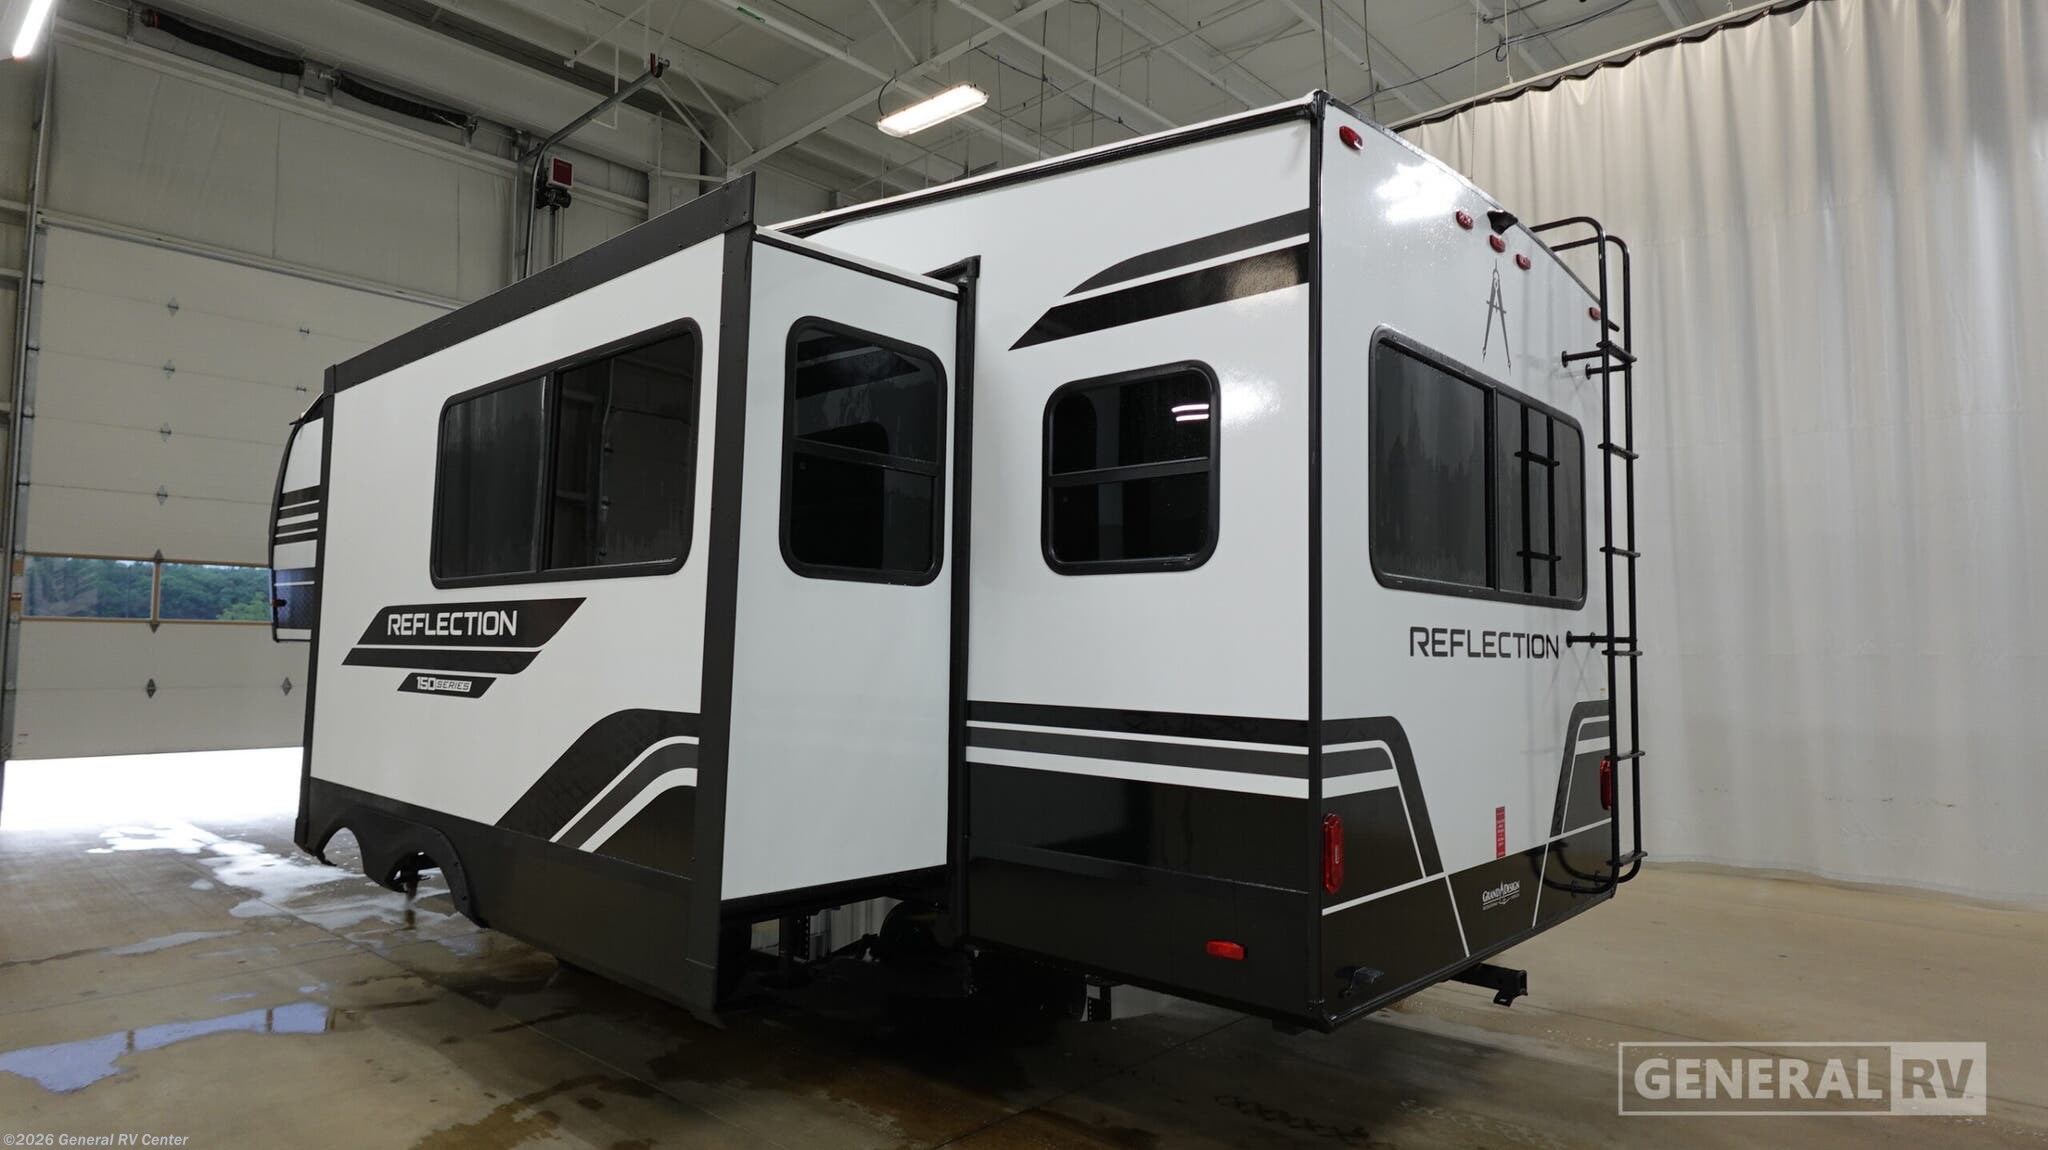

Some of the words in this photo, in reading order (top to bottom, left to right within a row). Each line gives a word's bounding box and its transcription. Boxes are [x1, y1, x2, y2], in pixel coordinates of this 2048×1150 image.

[387, 610, 518, 637] REFLECTION
[1409, 626, 1559, 660] REFLECTION
[417, 676, 436, 691] 150
[436, 679, 471, 691] SERIES
